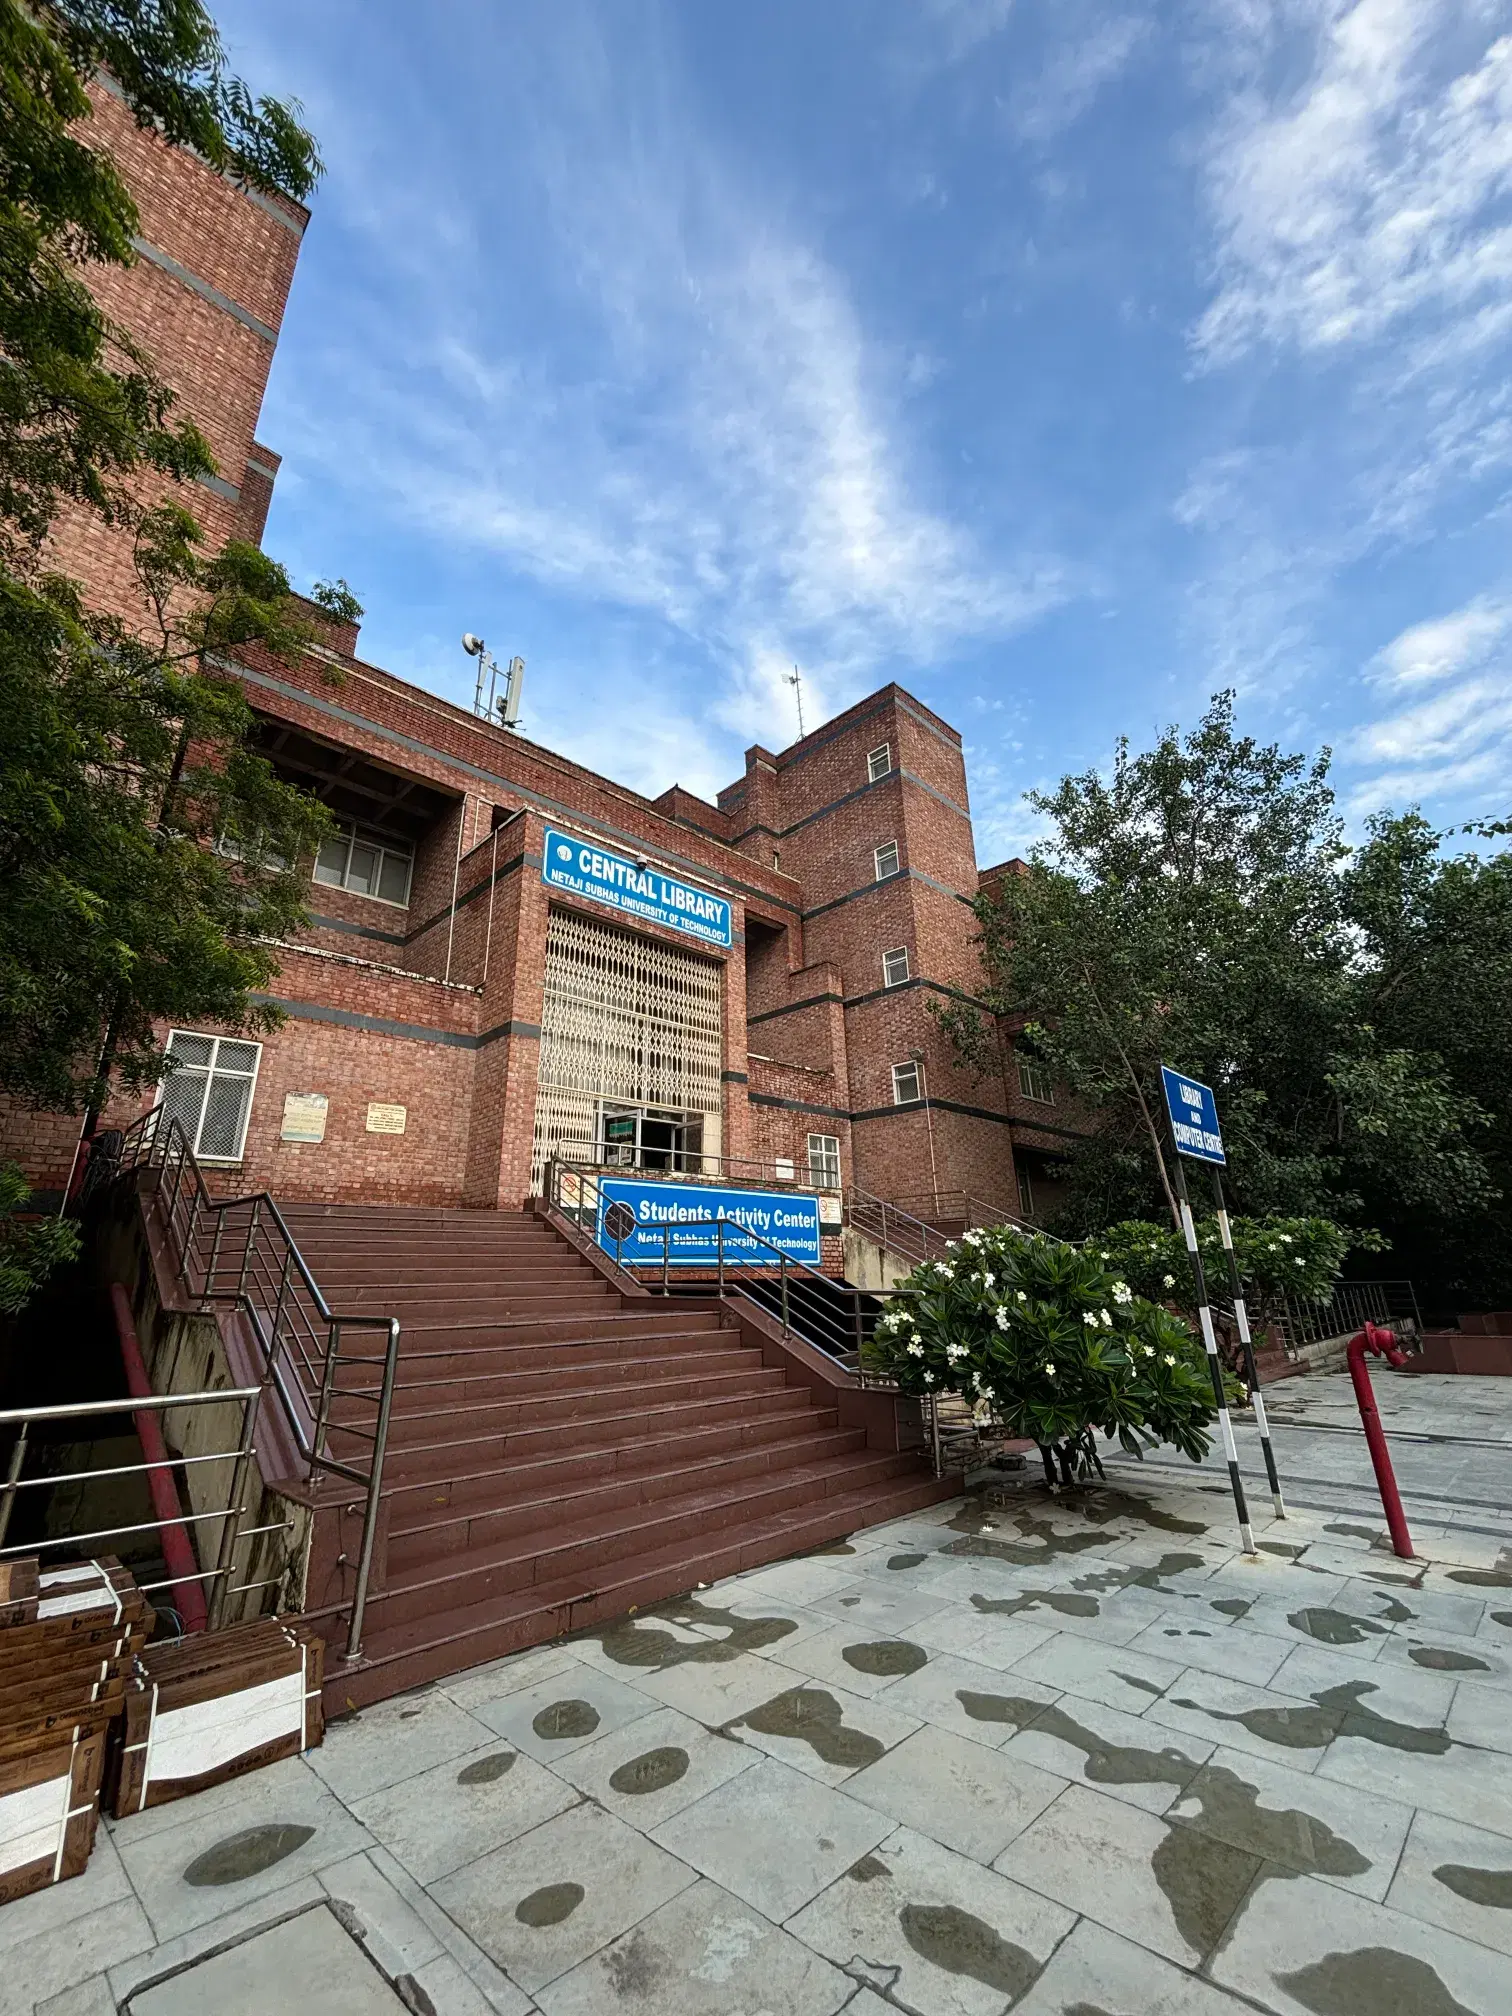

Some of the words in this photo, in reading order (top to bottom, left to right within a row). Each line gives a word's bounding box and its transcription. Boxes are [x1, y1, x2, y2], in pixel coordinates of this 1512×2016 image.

[578, 849, 658, 900] CENTRAL
[661, 881, 724, 925] LIBRARY
[551, 868, 584, 891] NETAJI
[584, 881, 620, 904] SUBHAS
[621, 894, 668, 921] UNIVERSITY
[668, 912, 680, 925] OF
[680, 916, 727, 942] TECHNOLOGY
[1179, 1082, 1203, 1110] LIBRARY
[1190, 1110, 1201, 1125] AND
[1173, 1120, 1205, 1150] COMPUTER
[639, 1199, 712, 1222] Students
[716, 1205, 770, 1231] Activity
[773, 1208, 816, 1229] Center
[637, 1231, 671, 1249] Netai
[672, 1232, 710, 1246] Subhas
[771, 1236, 817, 1251] Technology
